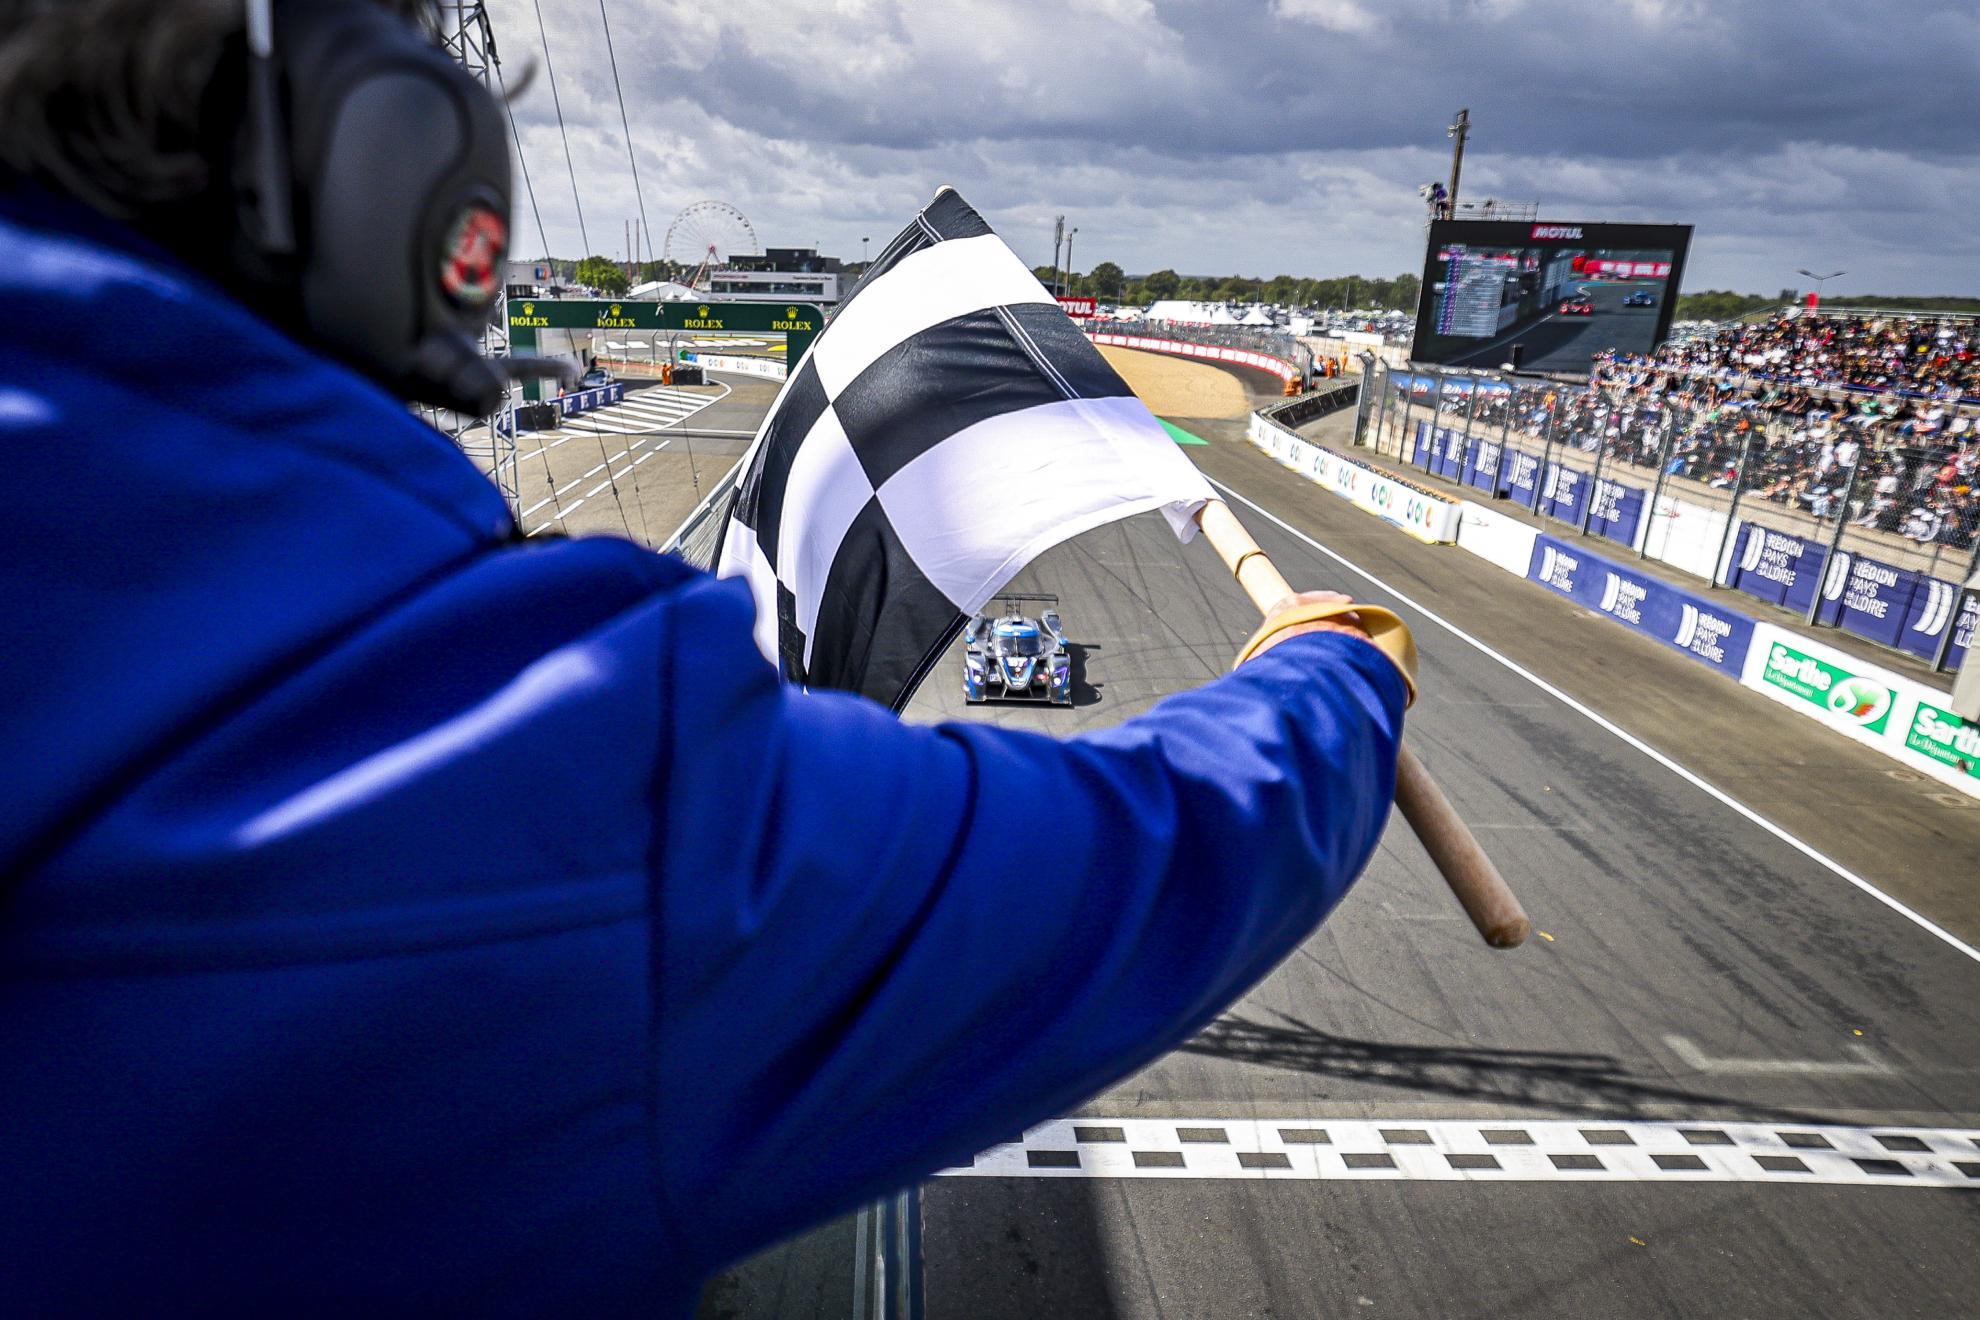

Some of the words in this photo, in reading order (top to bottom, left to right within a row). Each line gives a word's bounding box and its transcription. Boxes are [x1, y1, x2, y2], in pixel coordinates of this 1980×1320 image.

[1535, 226, 1583, 239] MOTUL
[1058, 300, 1093, 314] OTUL
[510, 316, 549, 327] ROLEX
[684, 318, 723, 329] ROLEX
[772, 320, 812, 331] ROLEX
[1762, 547, 1789, 568] PAYS
[1695, 626, 1719, 646] PAYS
[1768, 645, 1832, 691] Sarthe
[1913, 708, 1980, 759] Sarth
